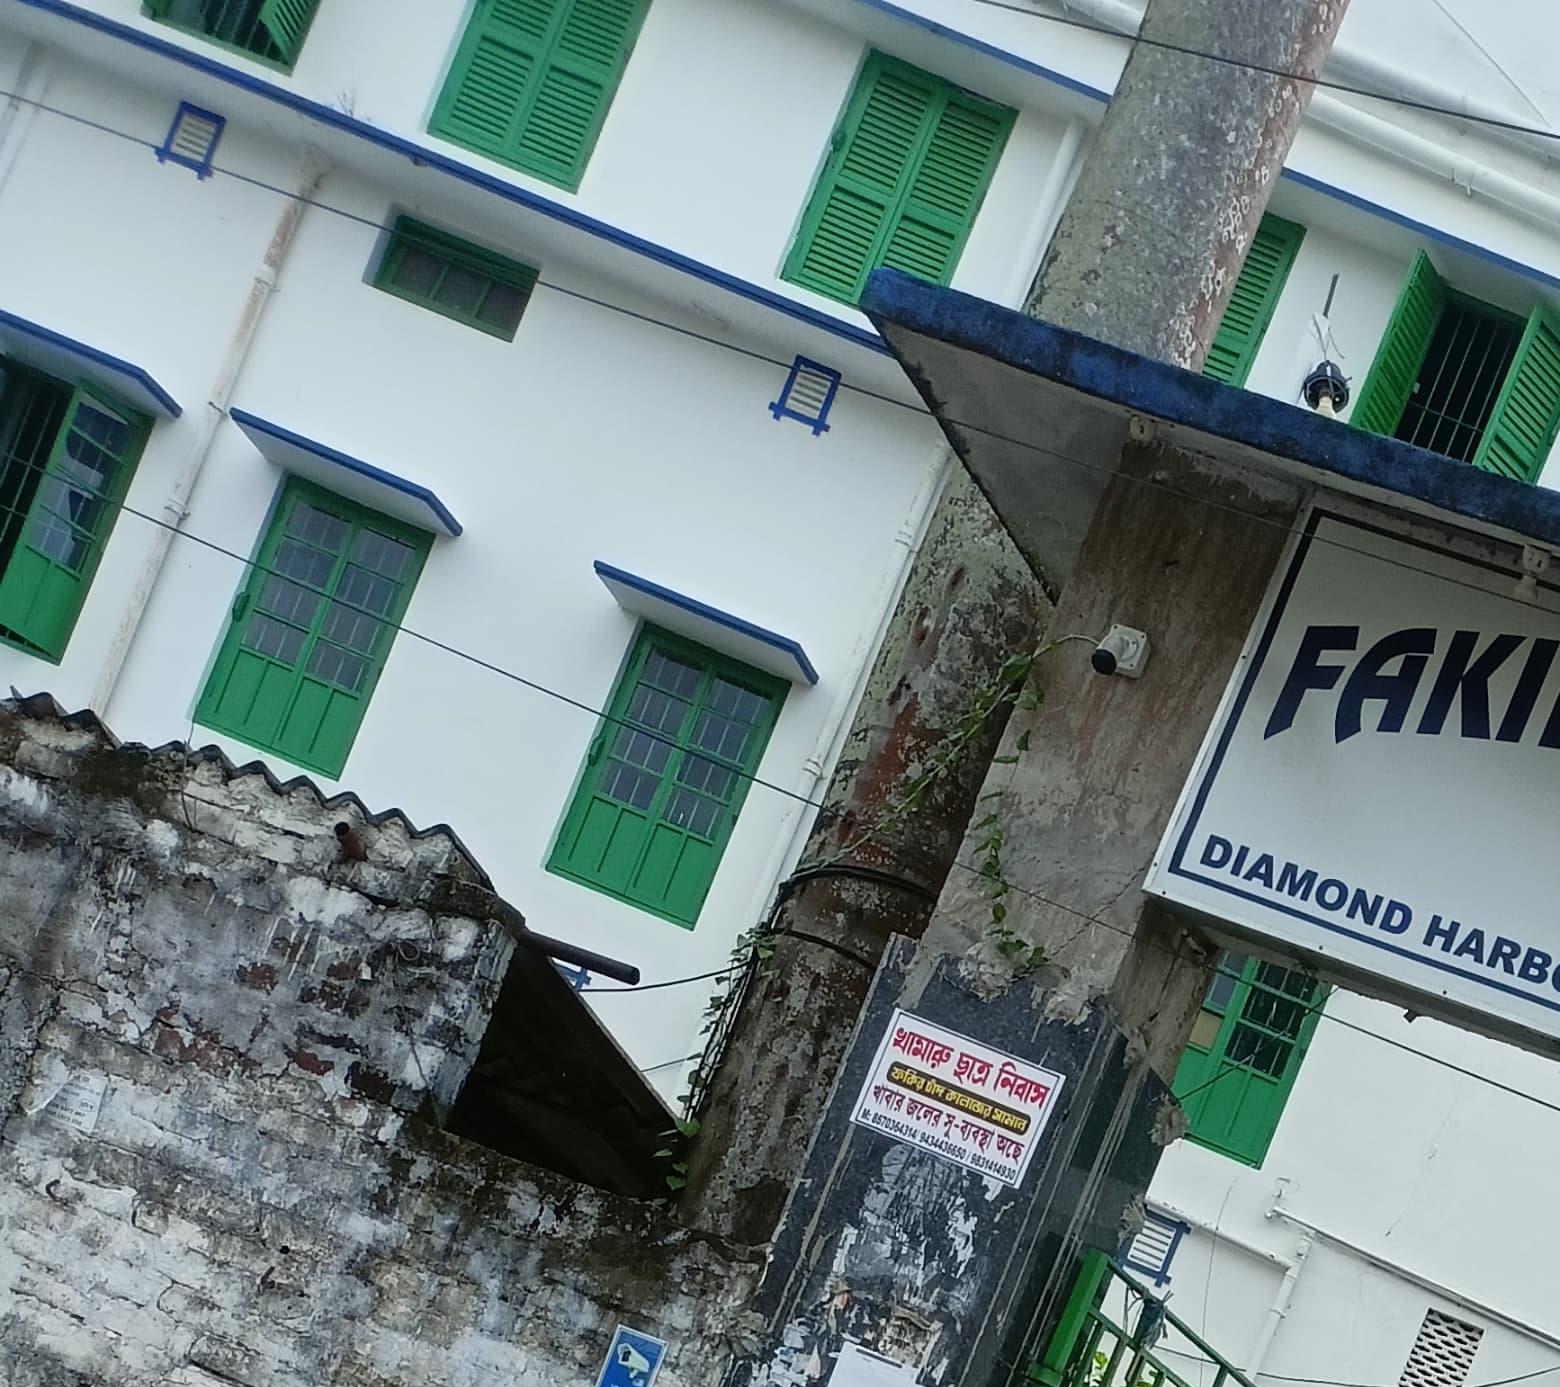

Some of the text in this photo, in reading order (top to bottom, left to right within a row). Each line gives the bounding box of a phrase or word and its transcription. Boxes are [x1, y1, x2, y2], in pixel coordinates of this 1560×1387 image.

[1200, 834, 1412, 936] DIAMOND
[873, 1084, 906, 1113] খাবার
[906, 1097, 944, 1127] জলের
[953, 1052, 994, 1087] ছাত্র
[993, 1061, 1051, 1110] নিবাস
